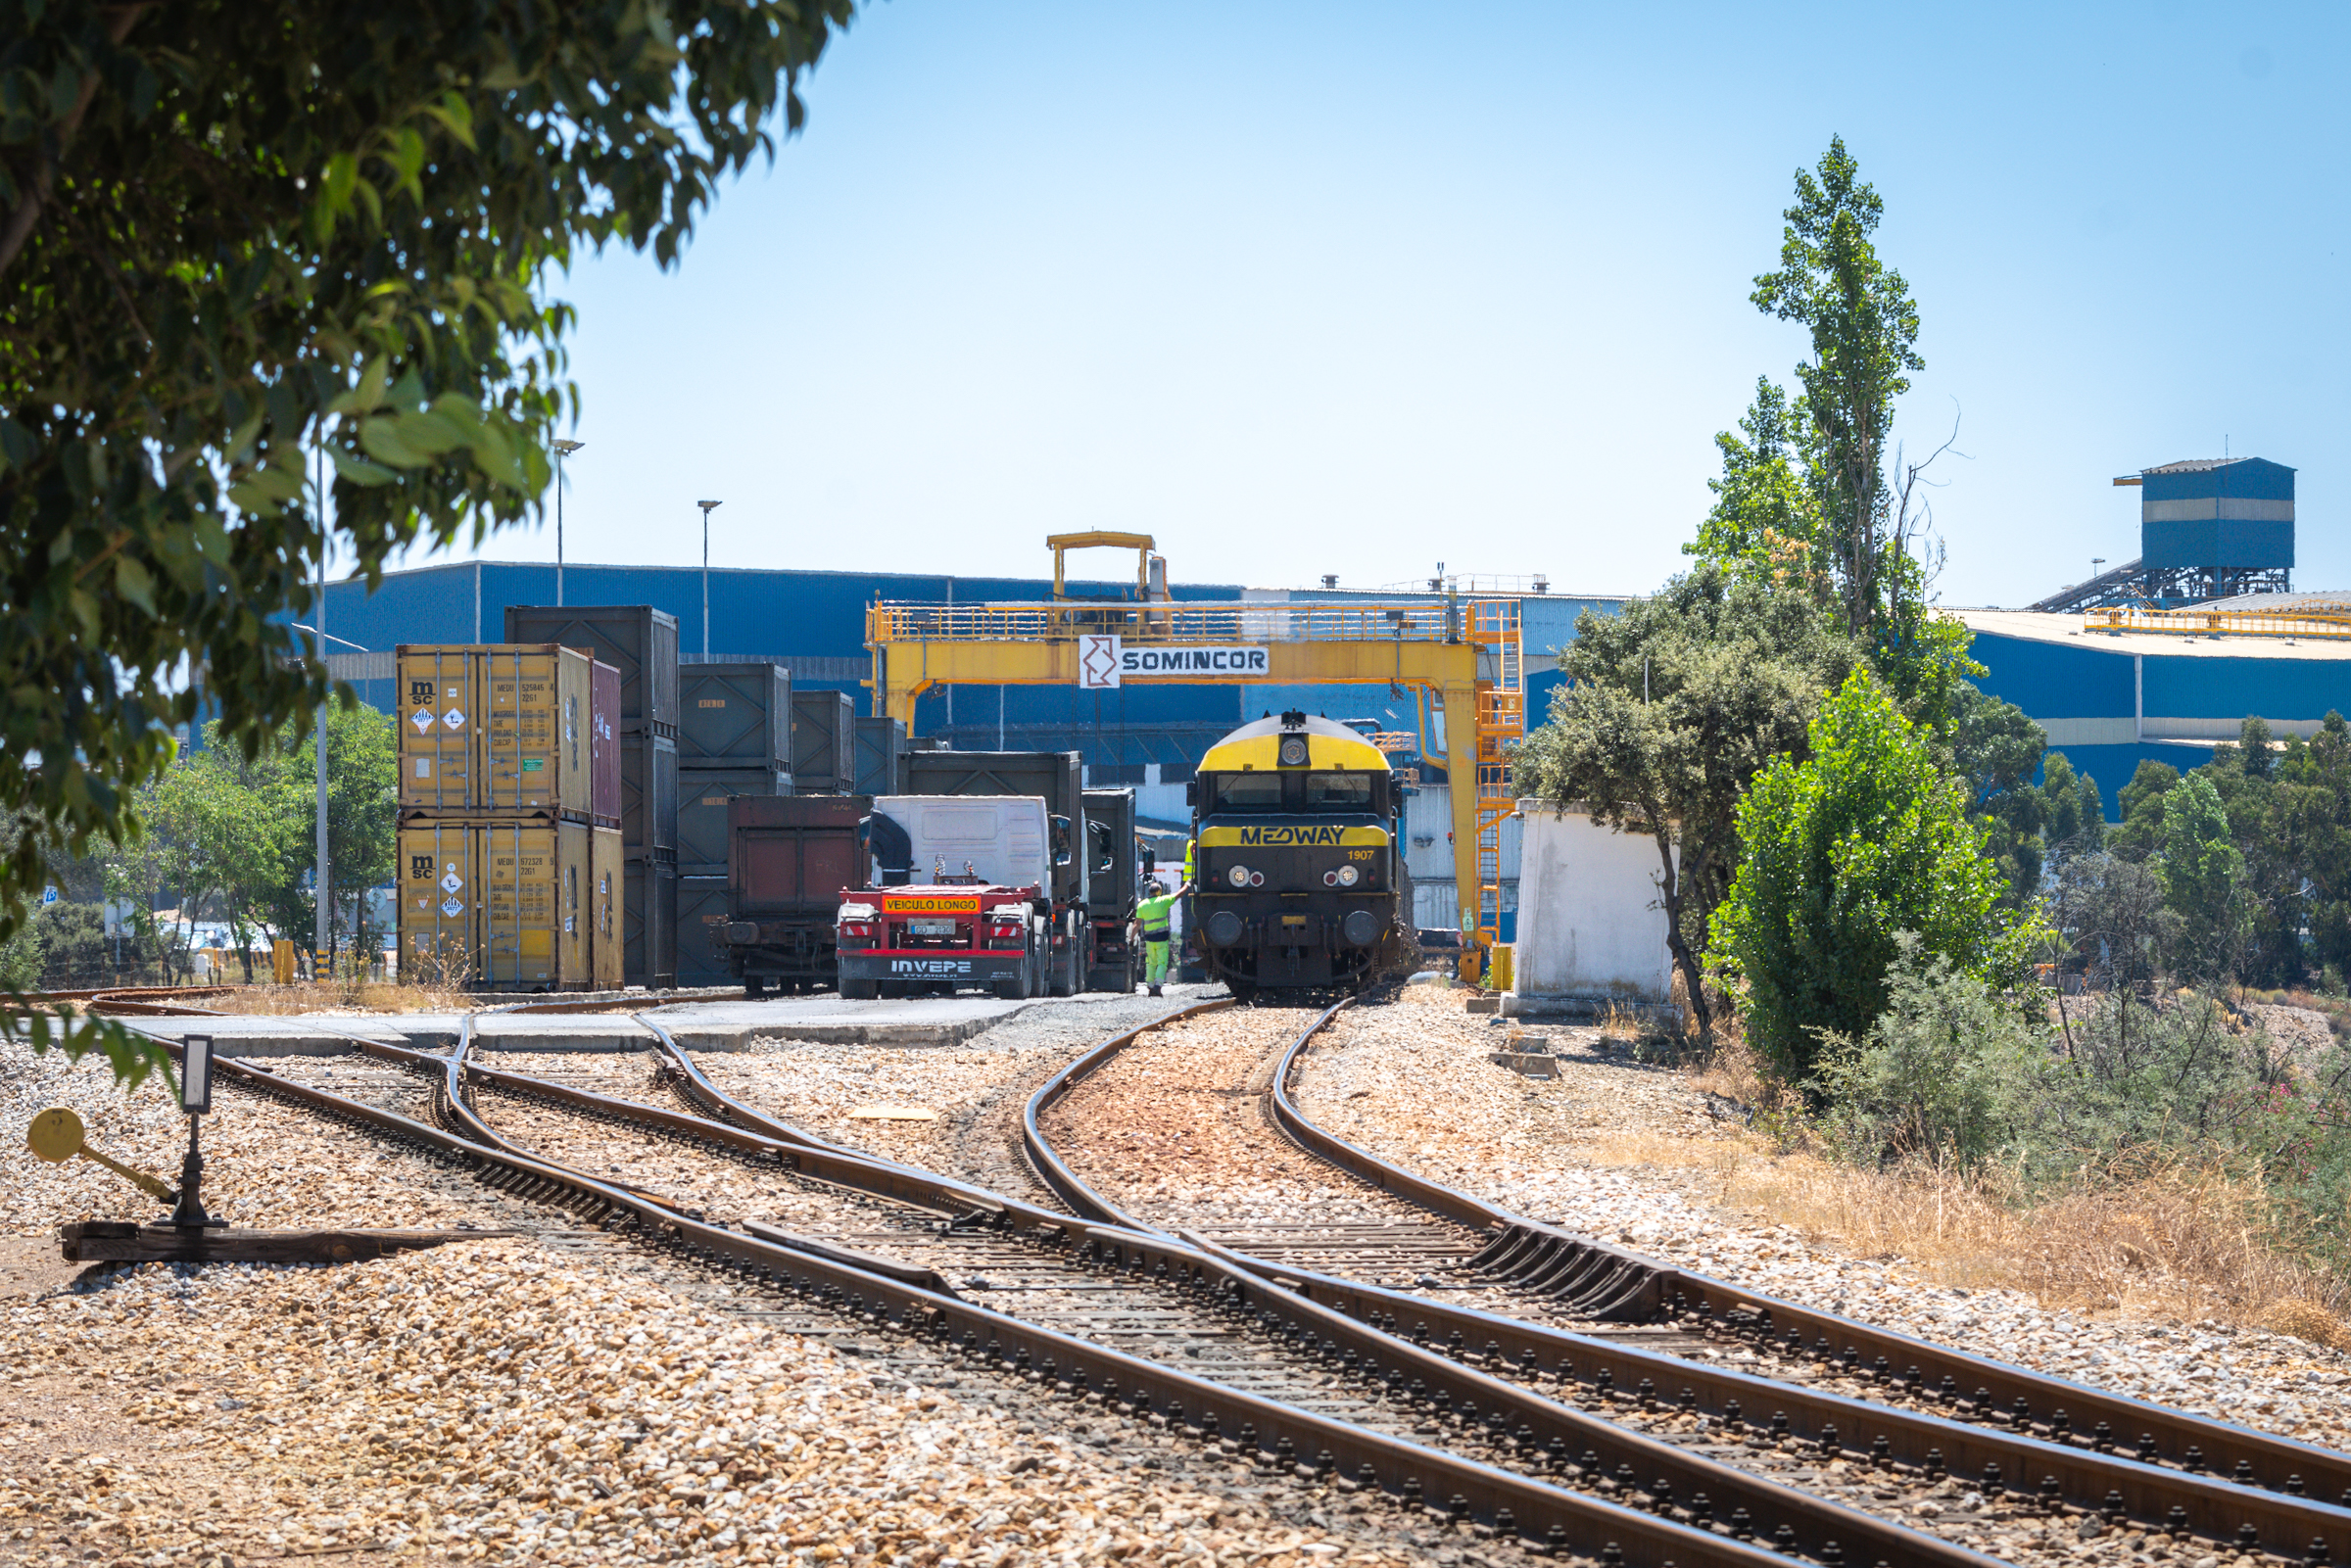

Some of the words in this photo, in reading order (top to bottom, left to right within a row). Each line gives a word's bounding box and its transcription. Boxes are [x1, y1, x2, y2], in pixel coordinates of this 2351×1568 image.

[1122, 650, 1266, 670] SOMINCOR
[497, 684, 514, 692] MEDU
[550, 684, 553, 692] 4
[521, 693, 537, 702] 22G1
[1240, 828, 1346, 844] MEDWAY
[1347, 850, 1374, 860] 1907
[497, 857, 514, 866] MEDU
[520, 857, 543, 866] 672328
[550, 857, 554, 866] 9
[887, 900, 935, 910] VEICULO
[937, 900, 977, 910] LONGO
